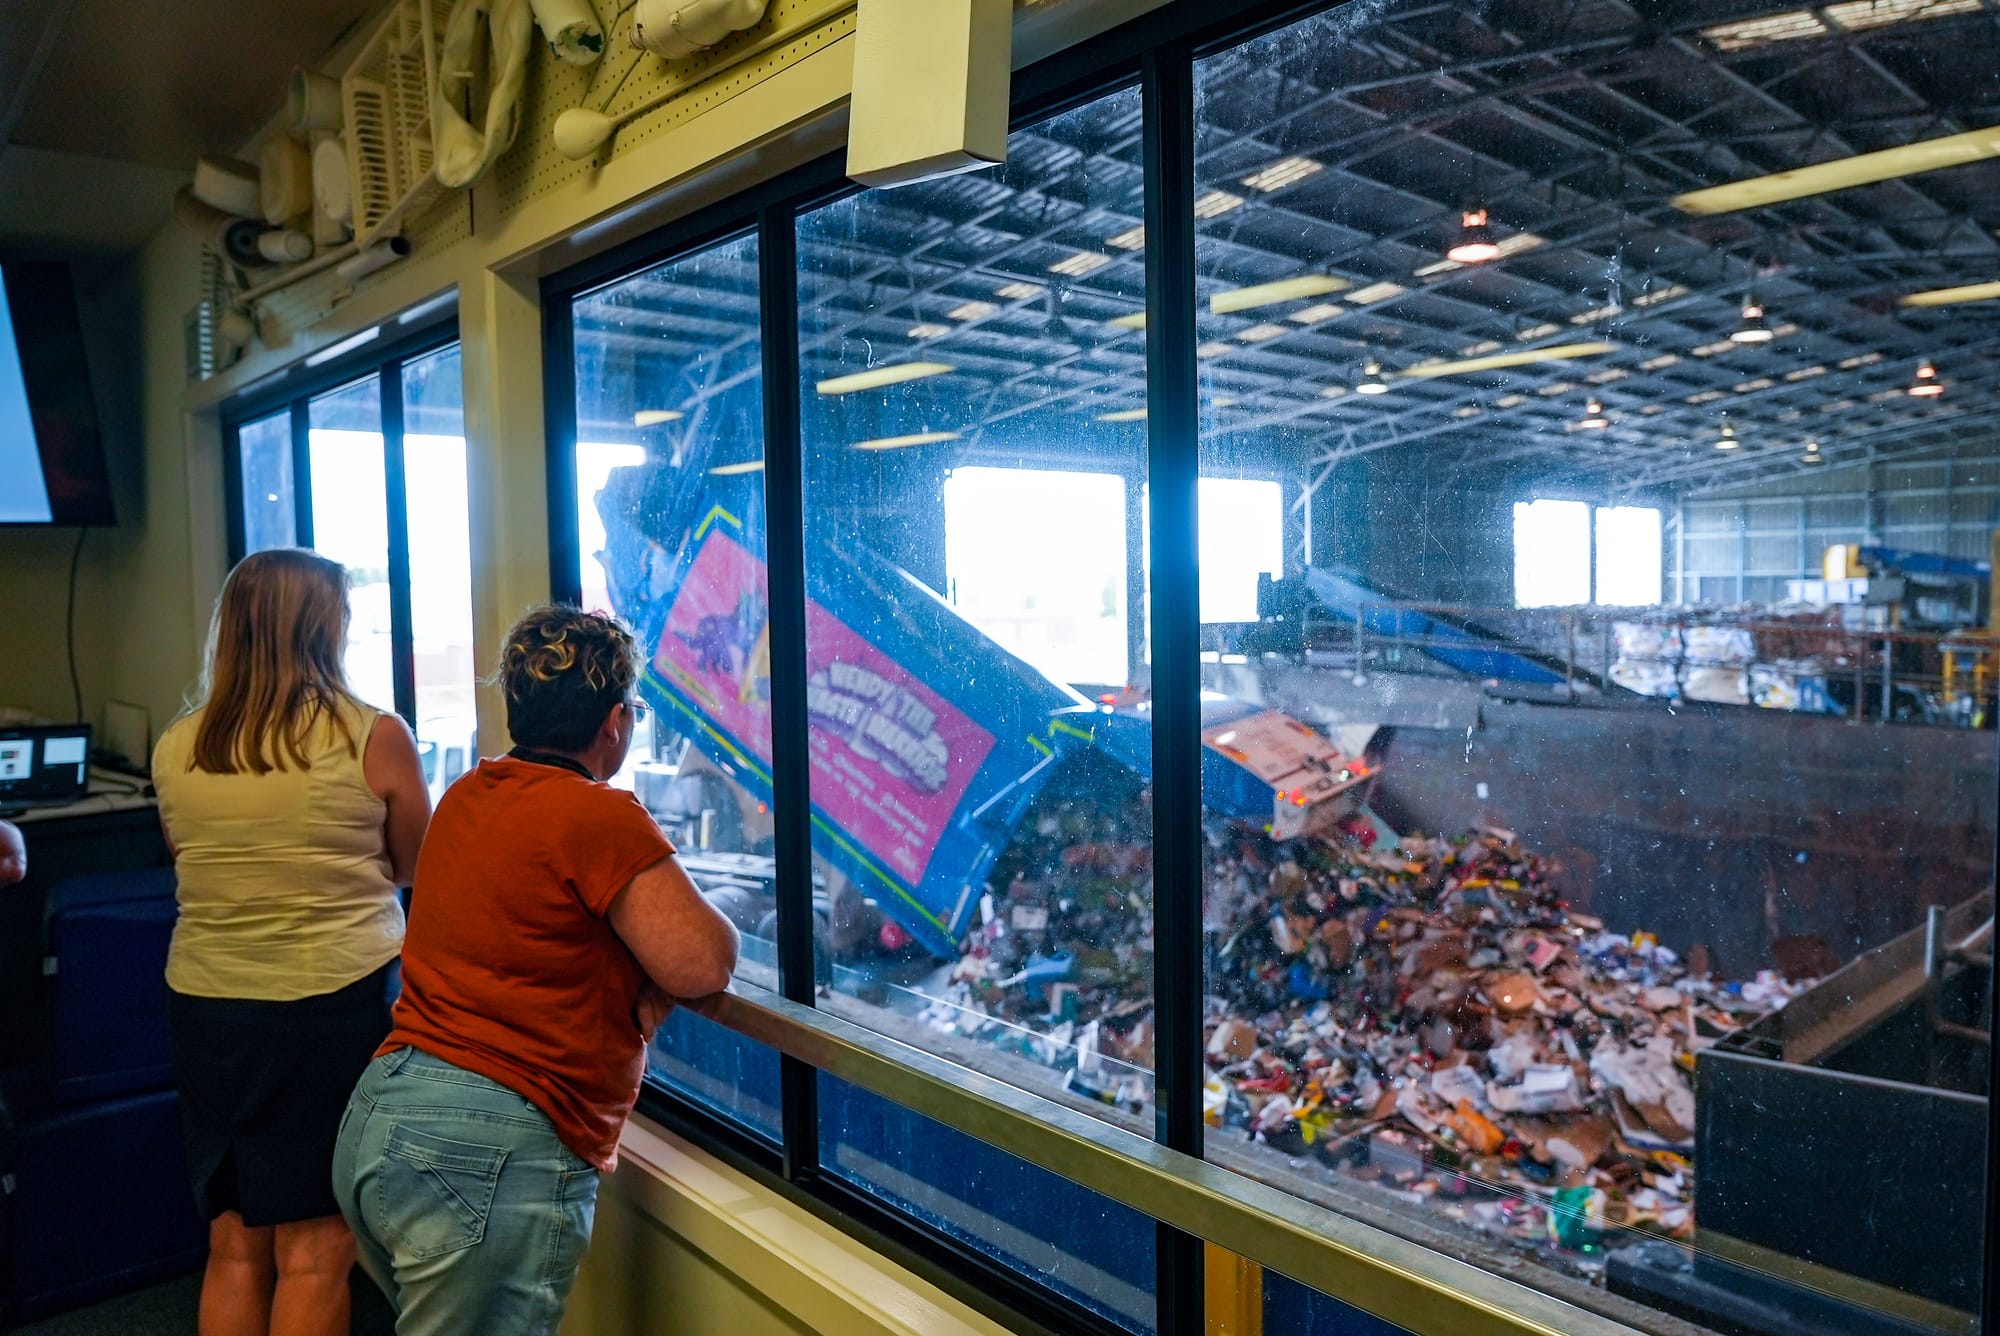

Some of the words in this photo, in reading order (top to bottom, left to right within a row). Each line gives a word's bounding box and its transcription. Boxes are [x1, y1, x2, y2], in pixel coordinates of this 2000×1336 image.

[830, 660, 896, 703] WENDY
[898, 690, 937, 736] THE
[864, 712, 947, 791] WARRIOR
